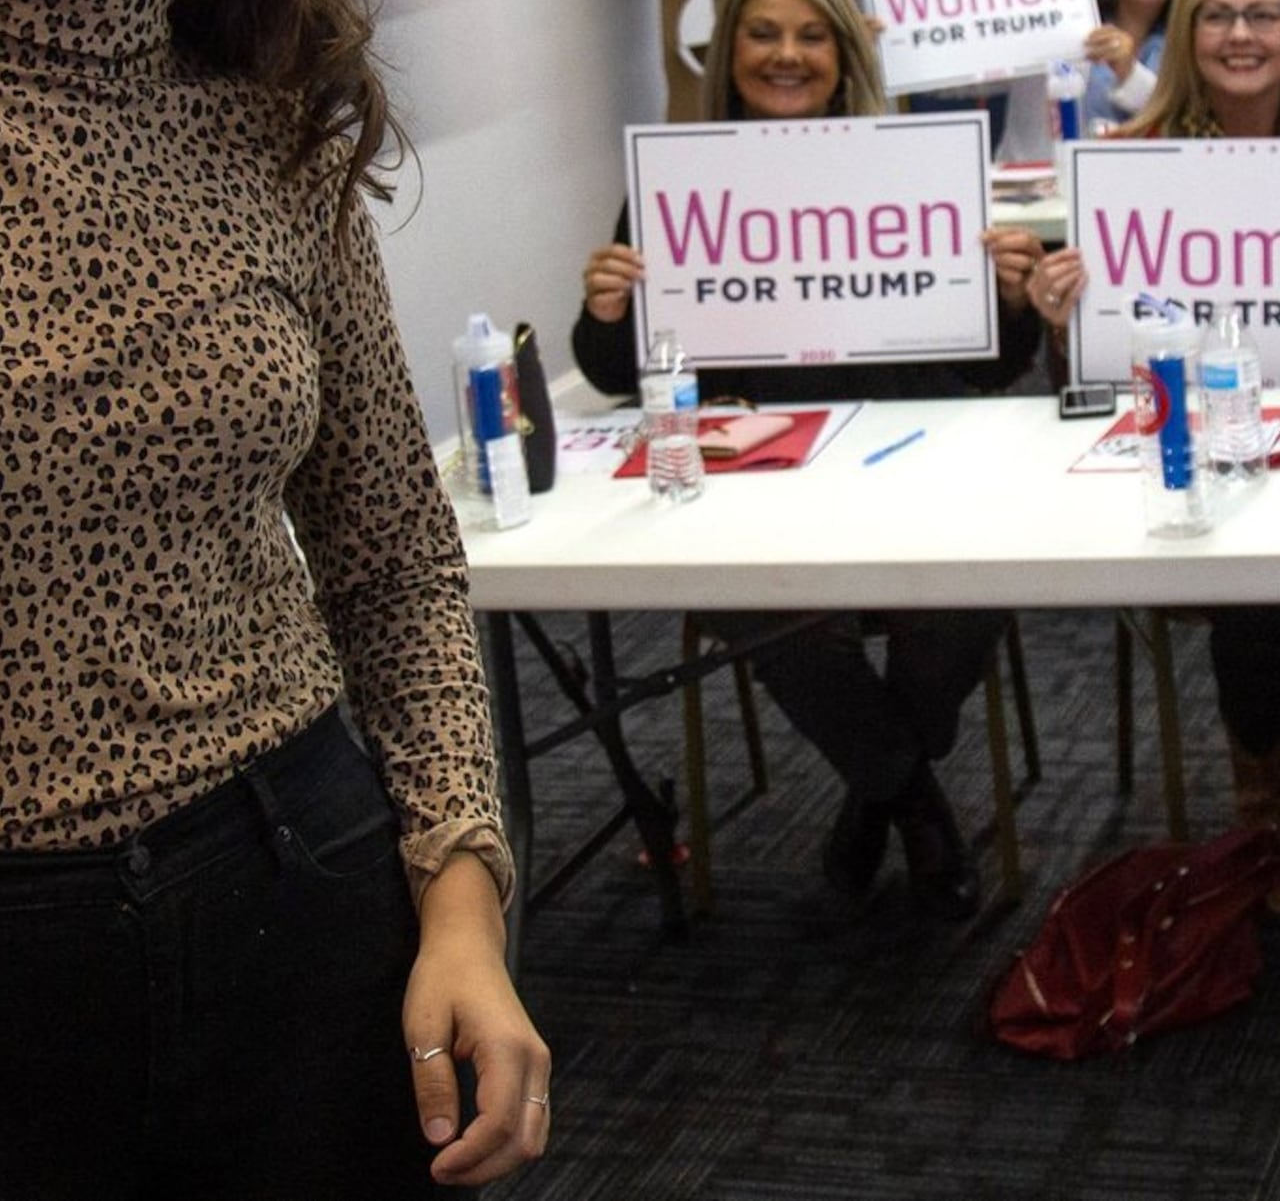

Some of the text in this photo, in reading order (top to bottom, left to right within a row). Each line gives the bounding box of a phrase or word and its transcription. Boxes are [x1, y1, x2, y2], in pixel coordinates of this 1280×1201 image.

[912, 10, 1063, 48] FOR TRUMP
[656, 189, 962, 266] Women
[695, 270, 936, 304] FOR TRUMP
